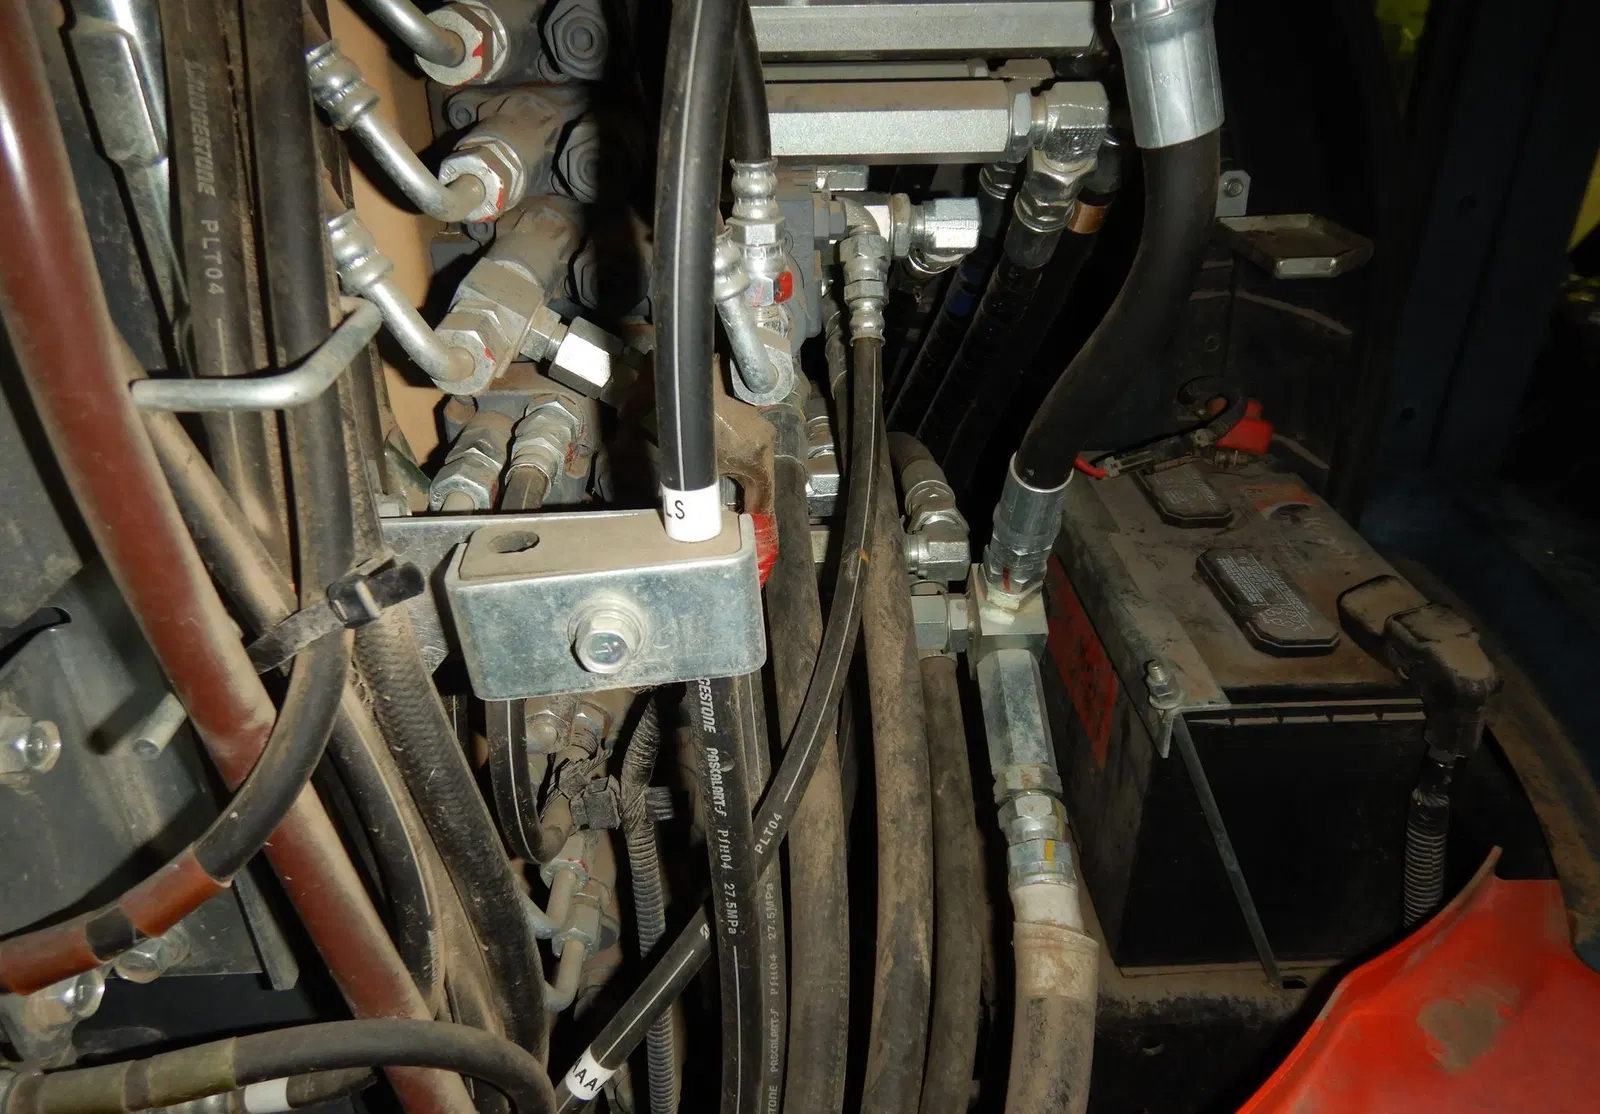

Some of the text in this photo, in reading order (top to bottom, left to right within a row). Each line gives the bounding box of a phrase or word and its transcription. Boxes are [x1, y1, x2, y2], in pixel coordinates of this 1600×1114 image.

[201, 220, 225, 295] PLT04
[664, 495, 685, 520] LS
[754, 813, 783, 855] PLT04
[724, 883, 738, 935] 27.5MPa
[766, 883, 777, 940] 27.5MPa
[767, 1085, 778, 1114] TONE
